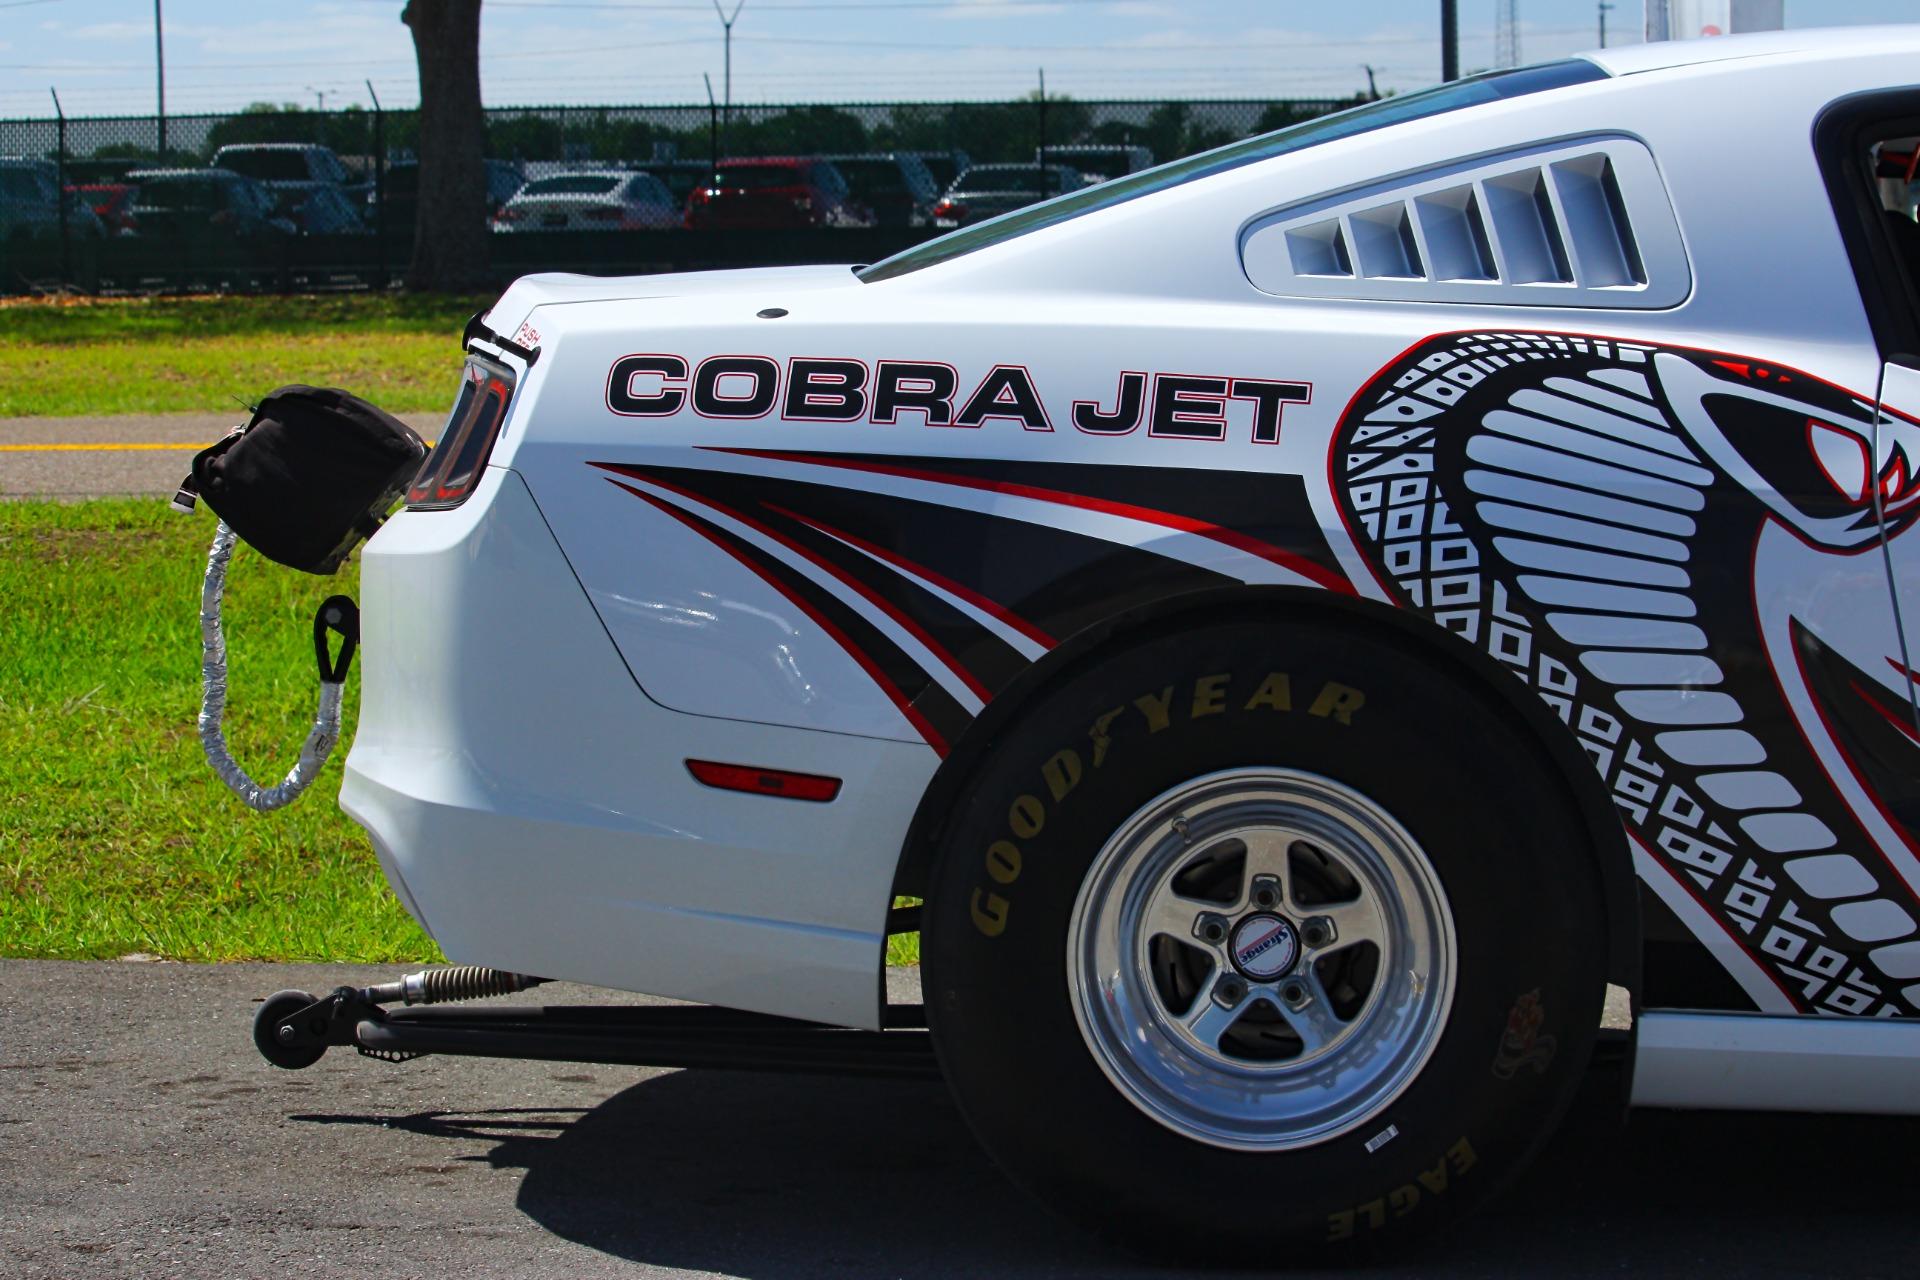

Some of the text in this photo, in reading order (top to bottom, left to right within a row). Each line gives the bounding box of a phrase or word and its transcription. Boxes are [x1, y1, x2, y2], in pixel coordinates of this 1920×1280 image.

[521, 323, 541, 345] PUSH
[605, 353, 1312, 444] COBRA JET
[1242, 929, 1288, 963] Strange
[1327, 1136, 1478, 1242] EAGLE
